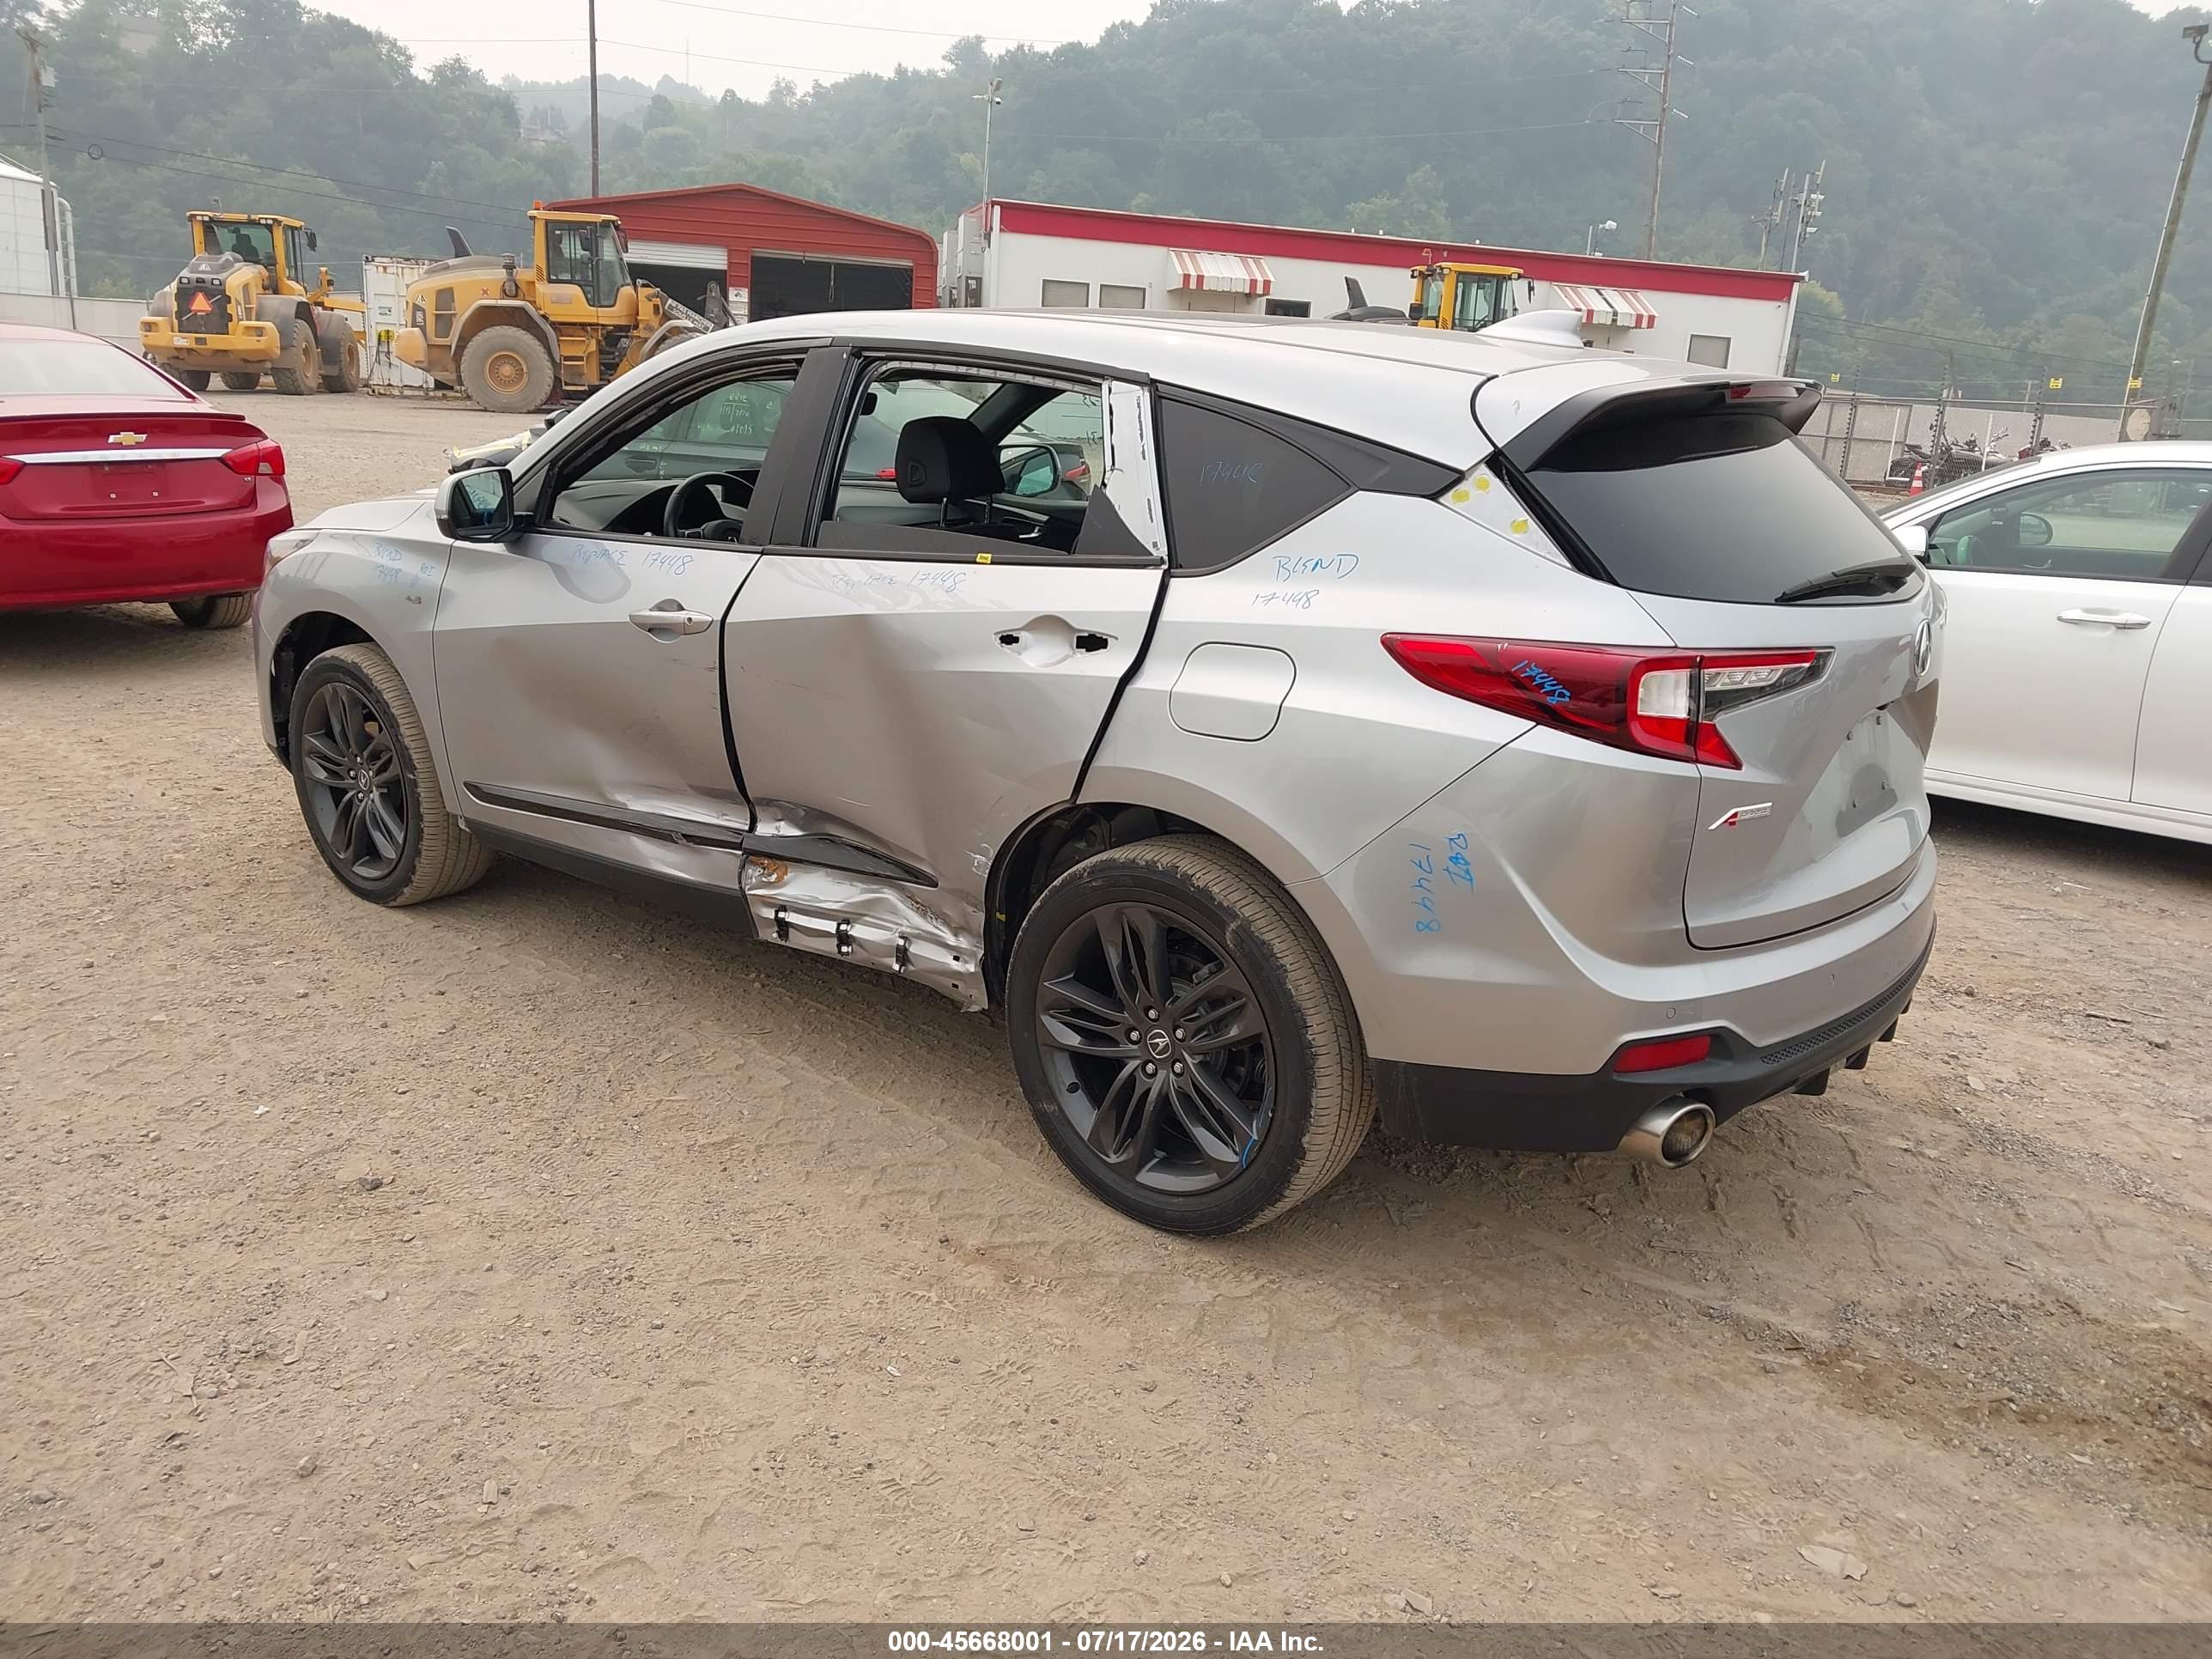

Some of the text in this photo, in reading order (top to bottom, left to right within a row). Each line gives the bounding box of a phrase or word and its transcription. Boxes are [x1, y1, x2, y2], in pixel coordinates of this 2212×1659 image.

[641, 551, 695, 576] 17448
[1273, 553, 1359, 582] BLEND
[1251, 589, 1320, 610] 17448
[1511, 659, 1571, 705] 17448
[1407, 843, 1441, 933] 17448
